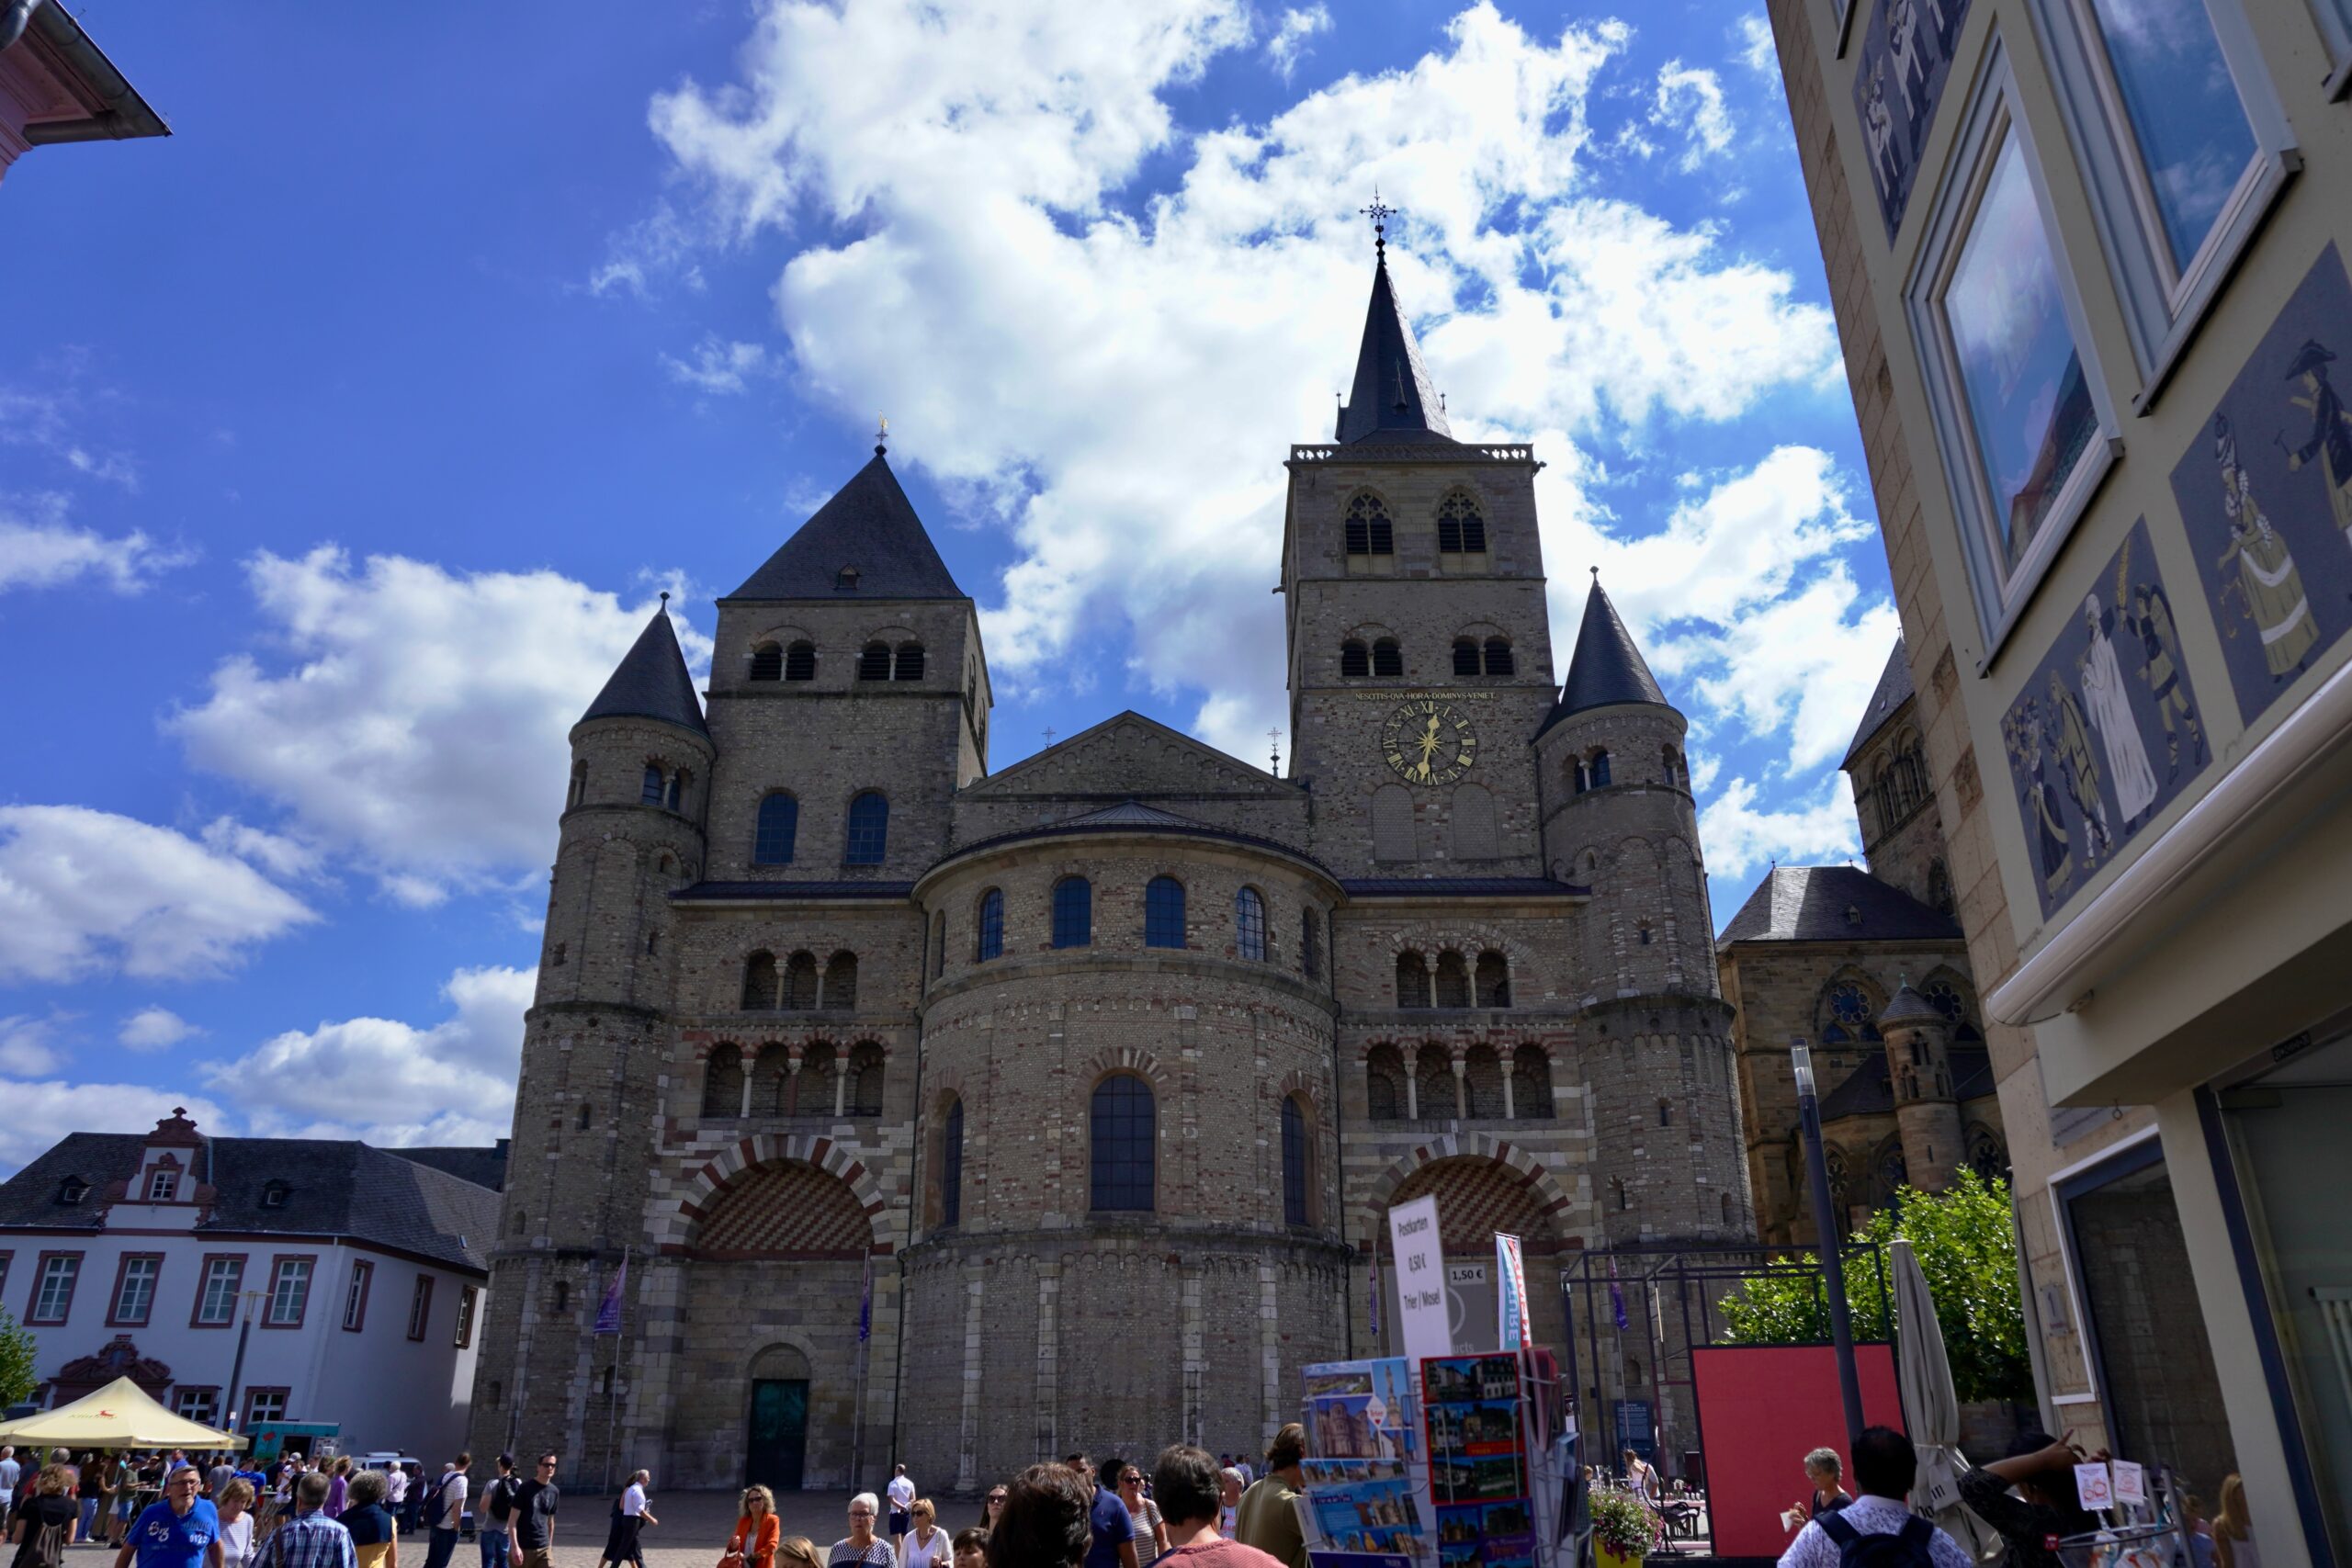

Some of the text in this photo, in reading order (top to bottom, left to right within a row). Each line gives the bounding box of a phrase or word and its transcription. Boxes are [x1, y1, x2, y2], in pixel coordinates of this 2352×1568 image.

[1397, 1216, 1429, 1237] Postkarten
[1453, 1269, 1483, 1281] 1,50 €
[1404, 1294, 1418, 1311] Trier
[1421, 1288, 1441, 1306] Mosel
